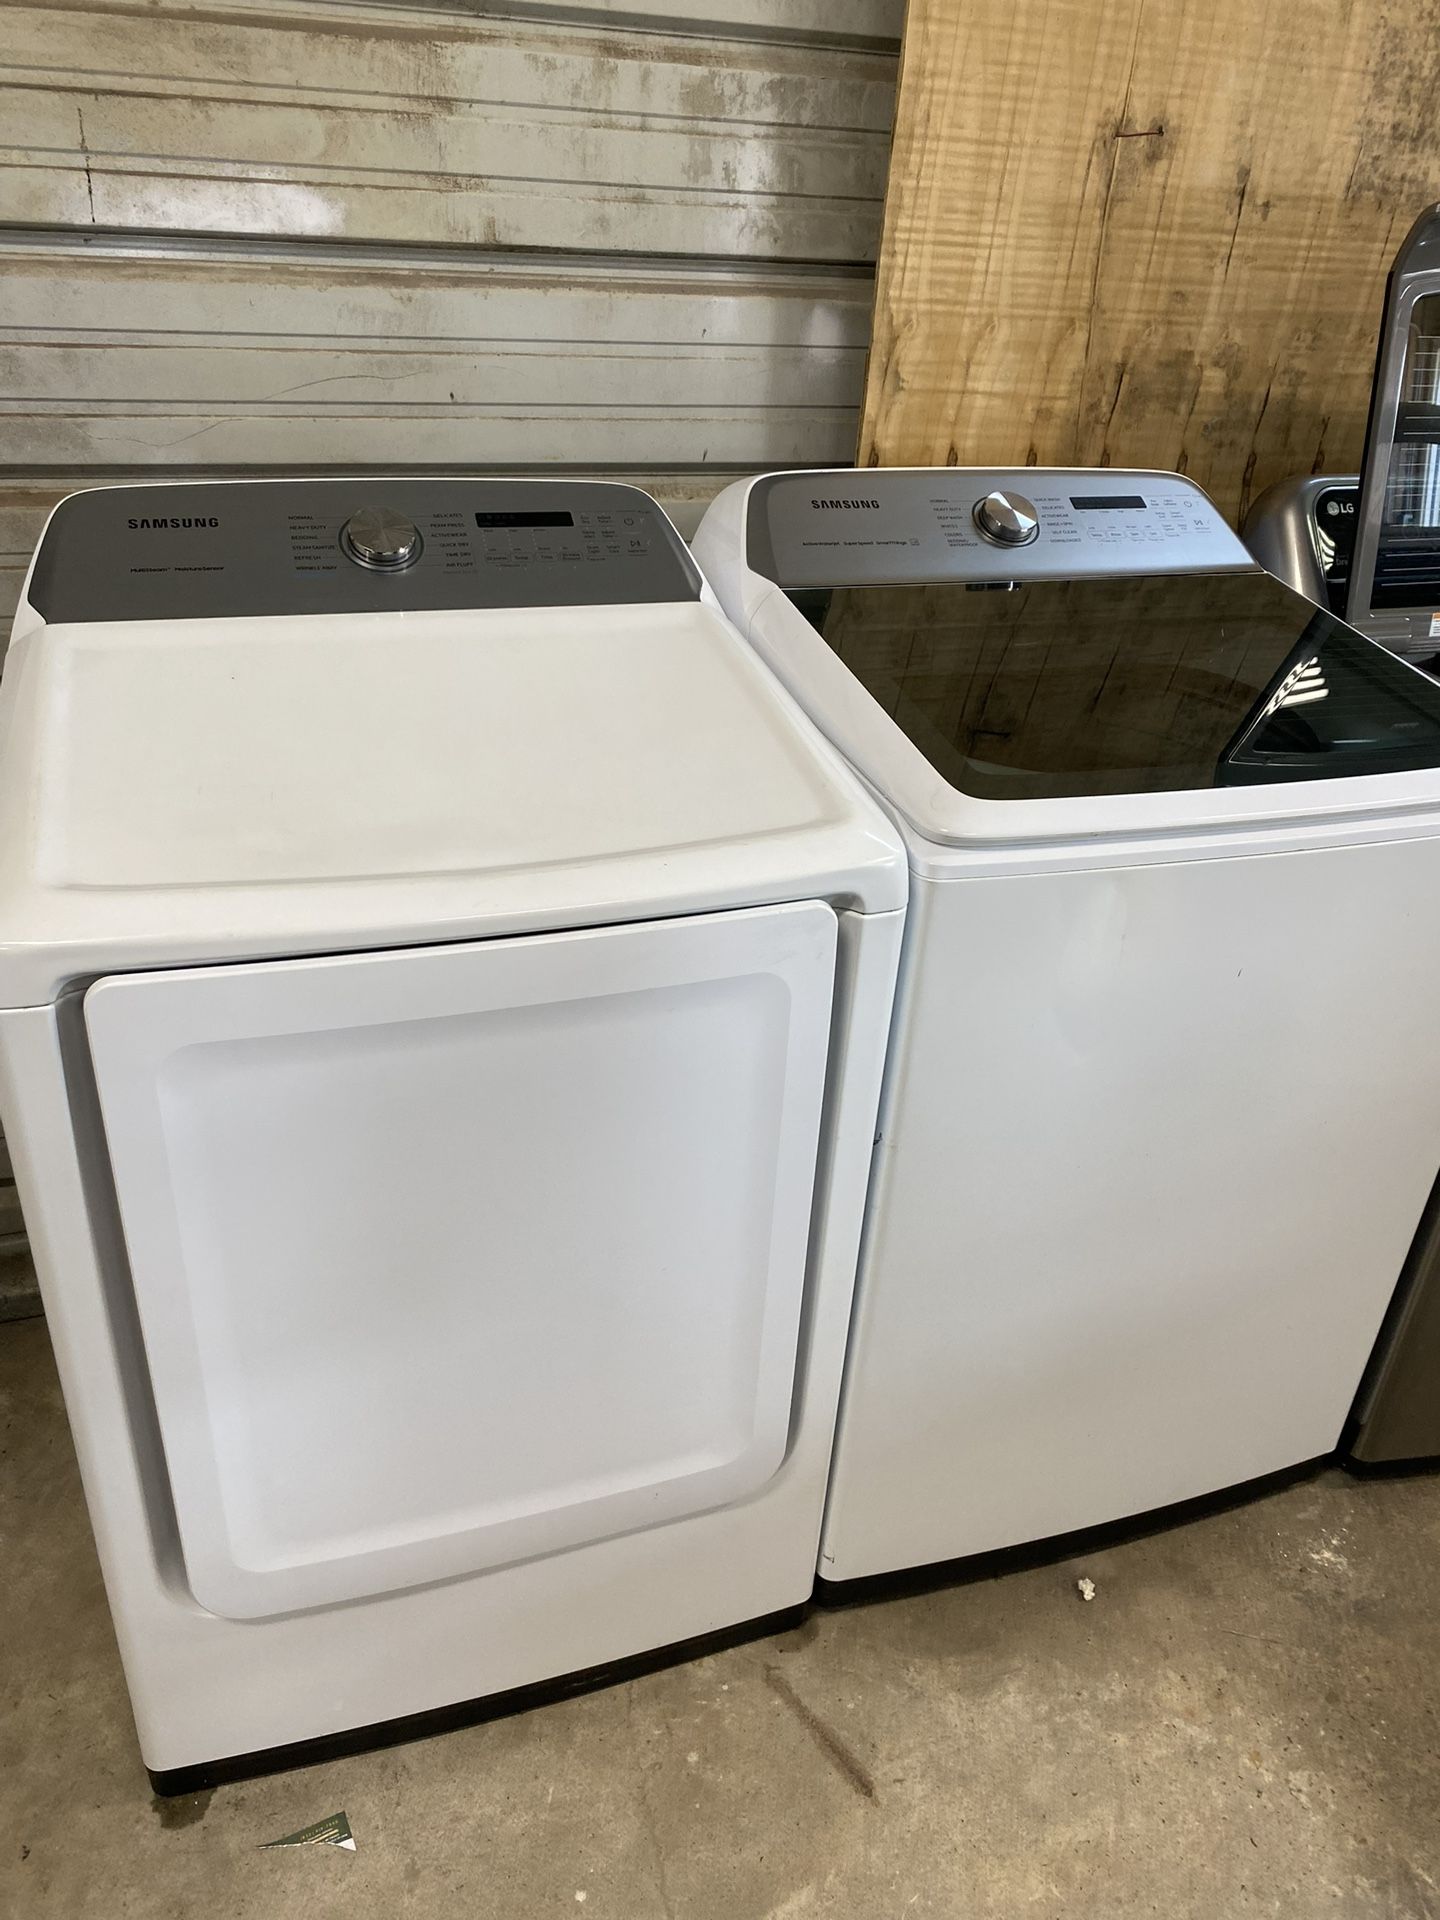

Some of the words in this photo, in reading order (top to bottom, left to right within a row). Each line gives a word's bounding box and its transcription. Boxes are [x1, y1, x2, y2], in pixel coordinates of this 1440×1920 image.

[811, 499, 880, 509] SAMSUNG
[1340, 503, 1354, 513] LG
[128, 517, 219, 529] SAMSUNG
